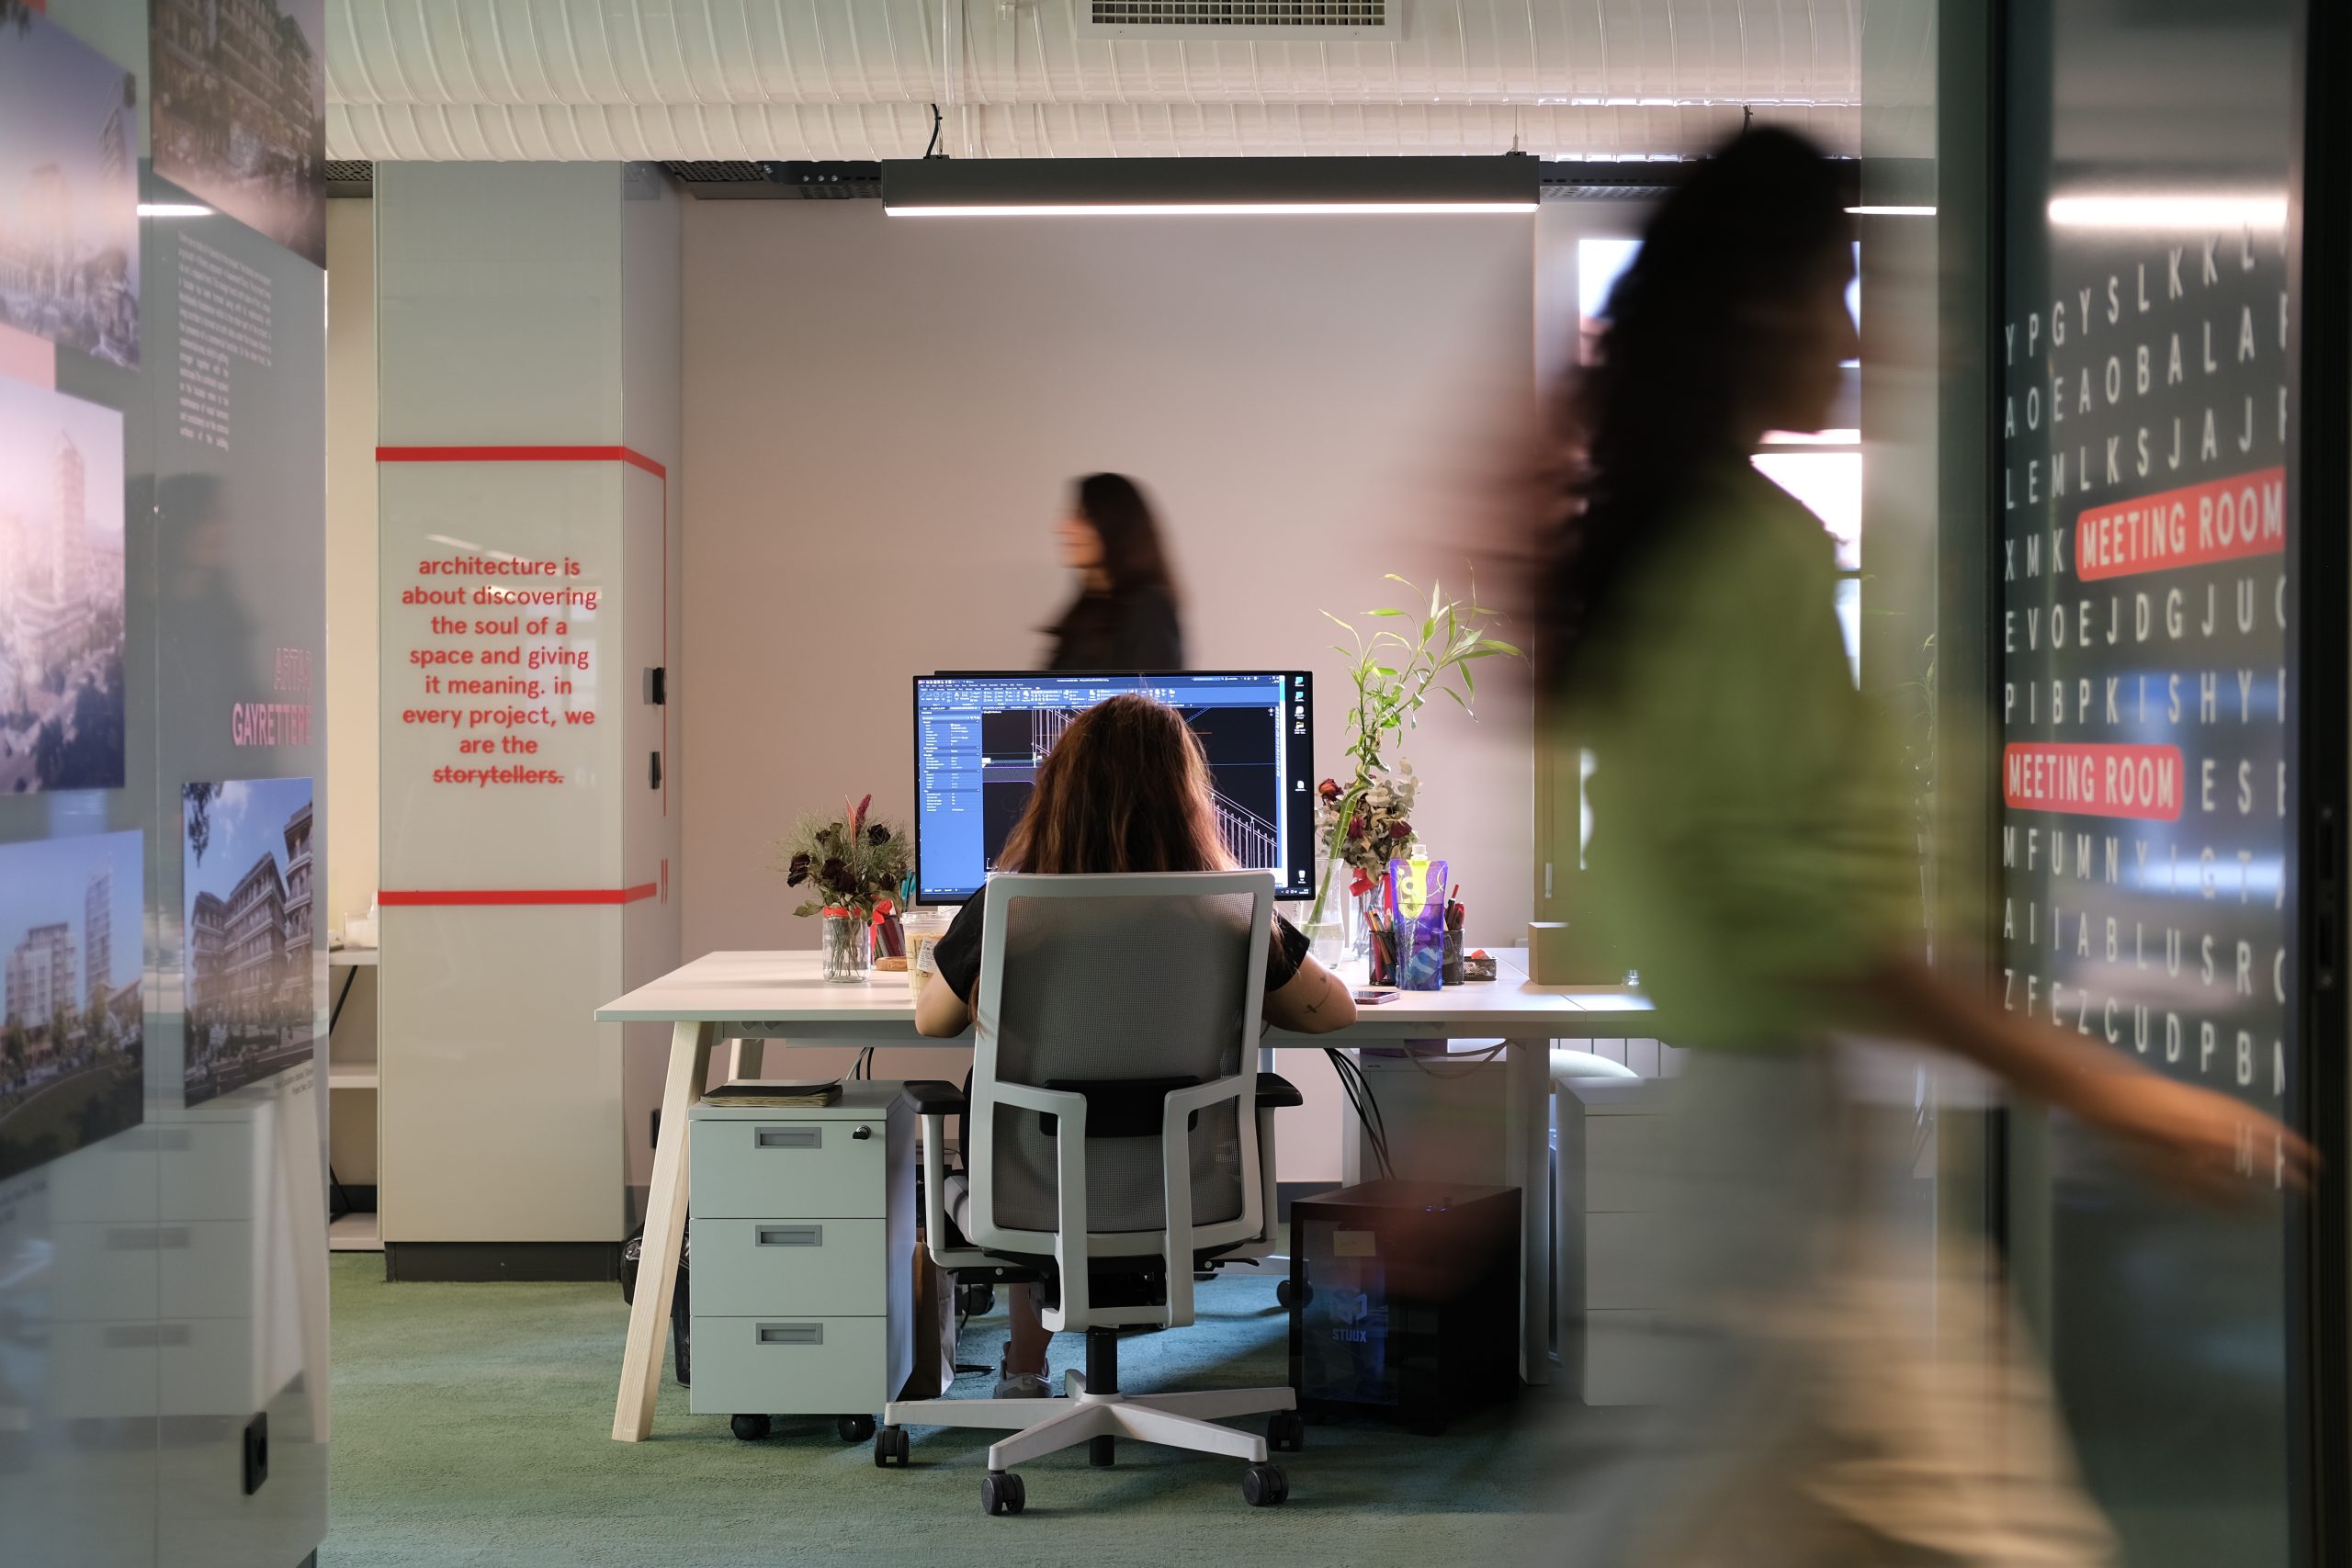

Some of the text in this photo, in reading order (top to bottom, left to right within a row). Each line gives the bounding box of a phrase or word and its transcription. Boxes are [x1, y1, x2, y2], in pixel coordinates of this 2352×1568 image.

[2082, 501, 2187, 570] MEETING
[2199, 480, 2283, 550] ROOM
[418, 556, 582, 576] architecture is
[401, 585, 598, 611] about discovering
[431, 615, 569, 637] the soul of a
[410, 646, 590, 671] space and giving
[424, 674, 572, 700] it meaning. in
[401, 705, 596, 729] every project, we
[458, 734, 539, 755] are the
[432, 763, 565, 788] storytellers.
[2008, 753, 2096, 804] MEETING
[2105, 755, 2175, 809] ROOM
